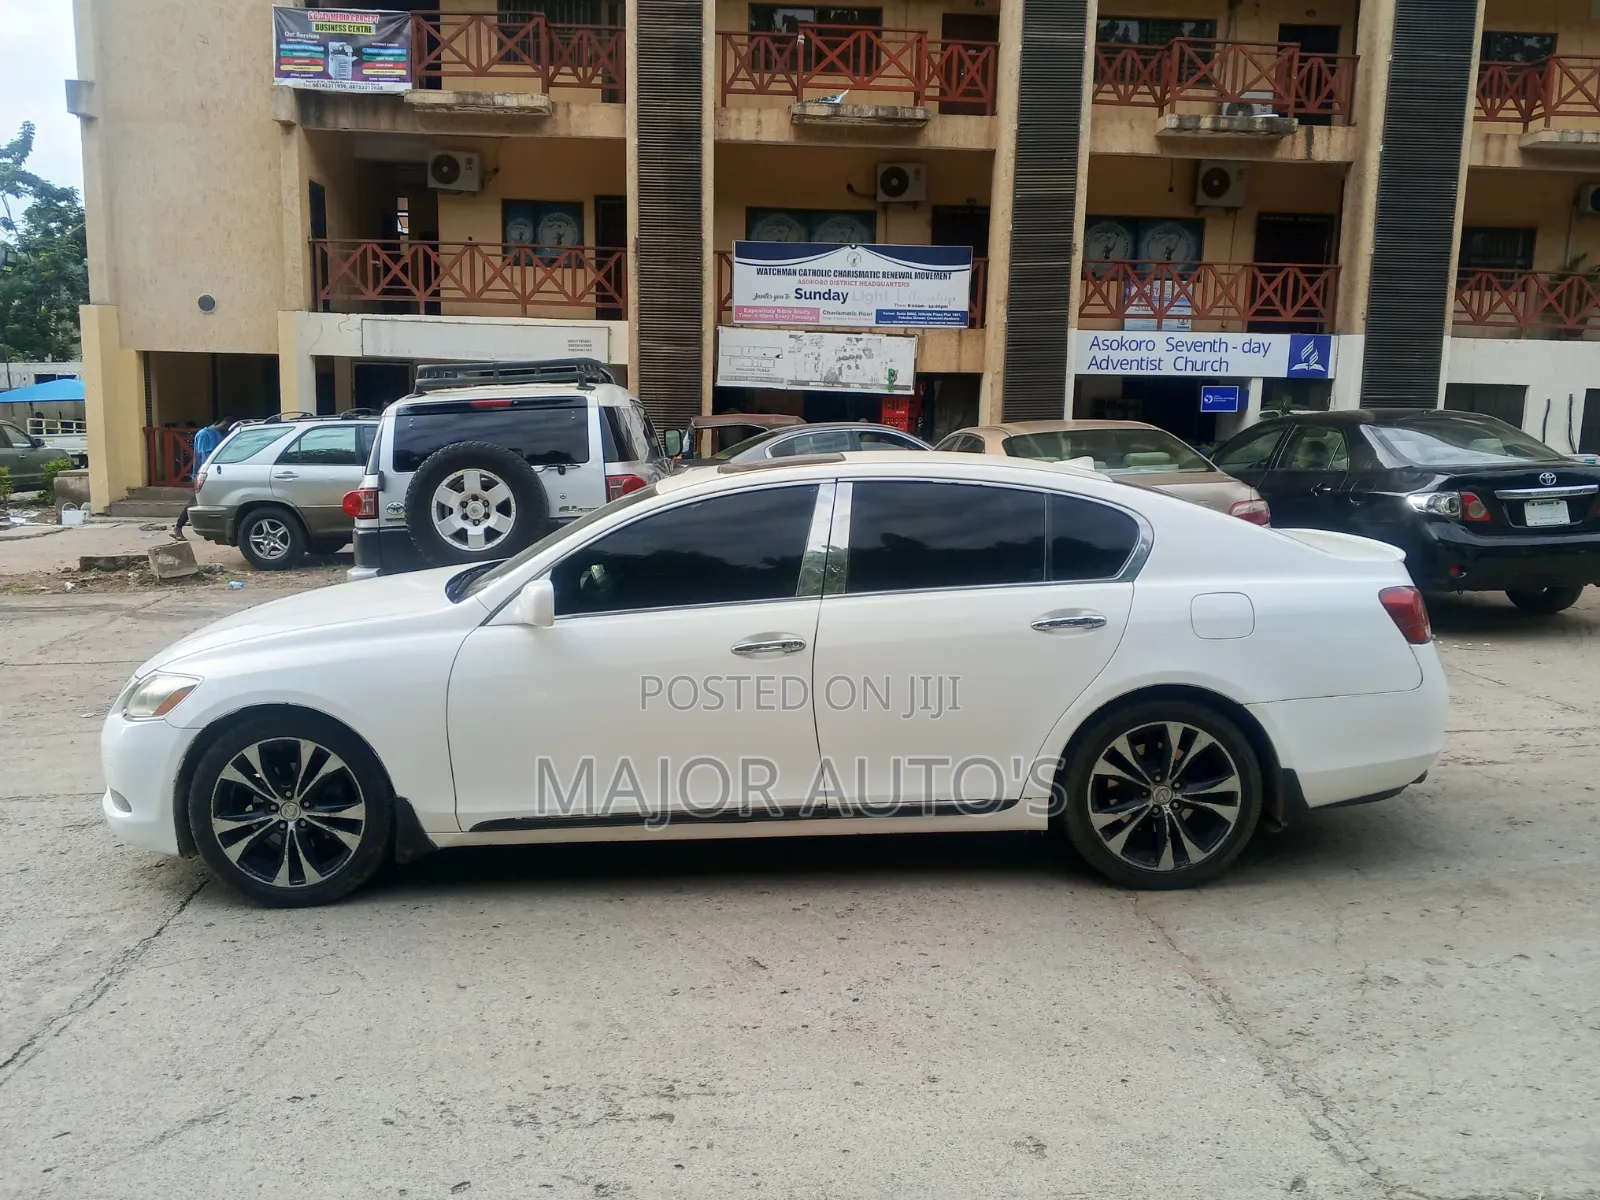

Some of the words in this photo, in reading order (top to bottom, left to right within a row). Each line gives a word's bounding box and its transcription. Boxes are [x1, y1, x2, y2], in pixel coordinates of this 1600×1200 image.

[330, 12, 349, 22] MEDIA
[351, 13, 379, 24] CONCEPT
[315, 23, 347, 32] BUSINESS
[348, 24, 372, 33] CENTRE
[296, 31, 320, 39] Services
[756, 267, 797, 276] WATCHMAN
[798, 268, 832, 277] CATHOLIC
[833, 269, 880, 279] CHARISMATIC
[881, 271, 913, 279] RENEWAL
[914, 271, 952, 280] MOVEMENT
[794, 288, 849, 304] Sunday
[852, 290, 889, 305] Light
[1088, 336, 1156, 352] Asokoro
[1087, 355, 1163, 371] Adventist
[1173, 356, 1229, 372] Church
